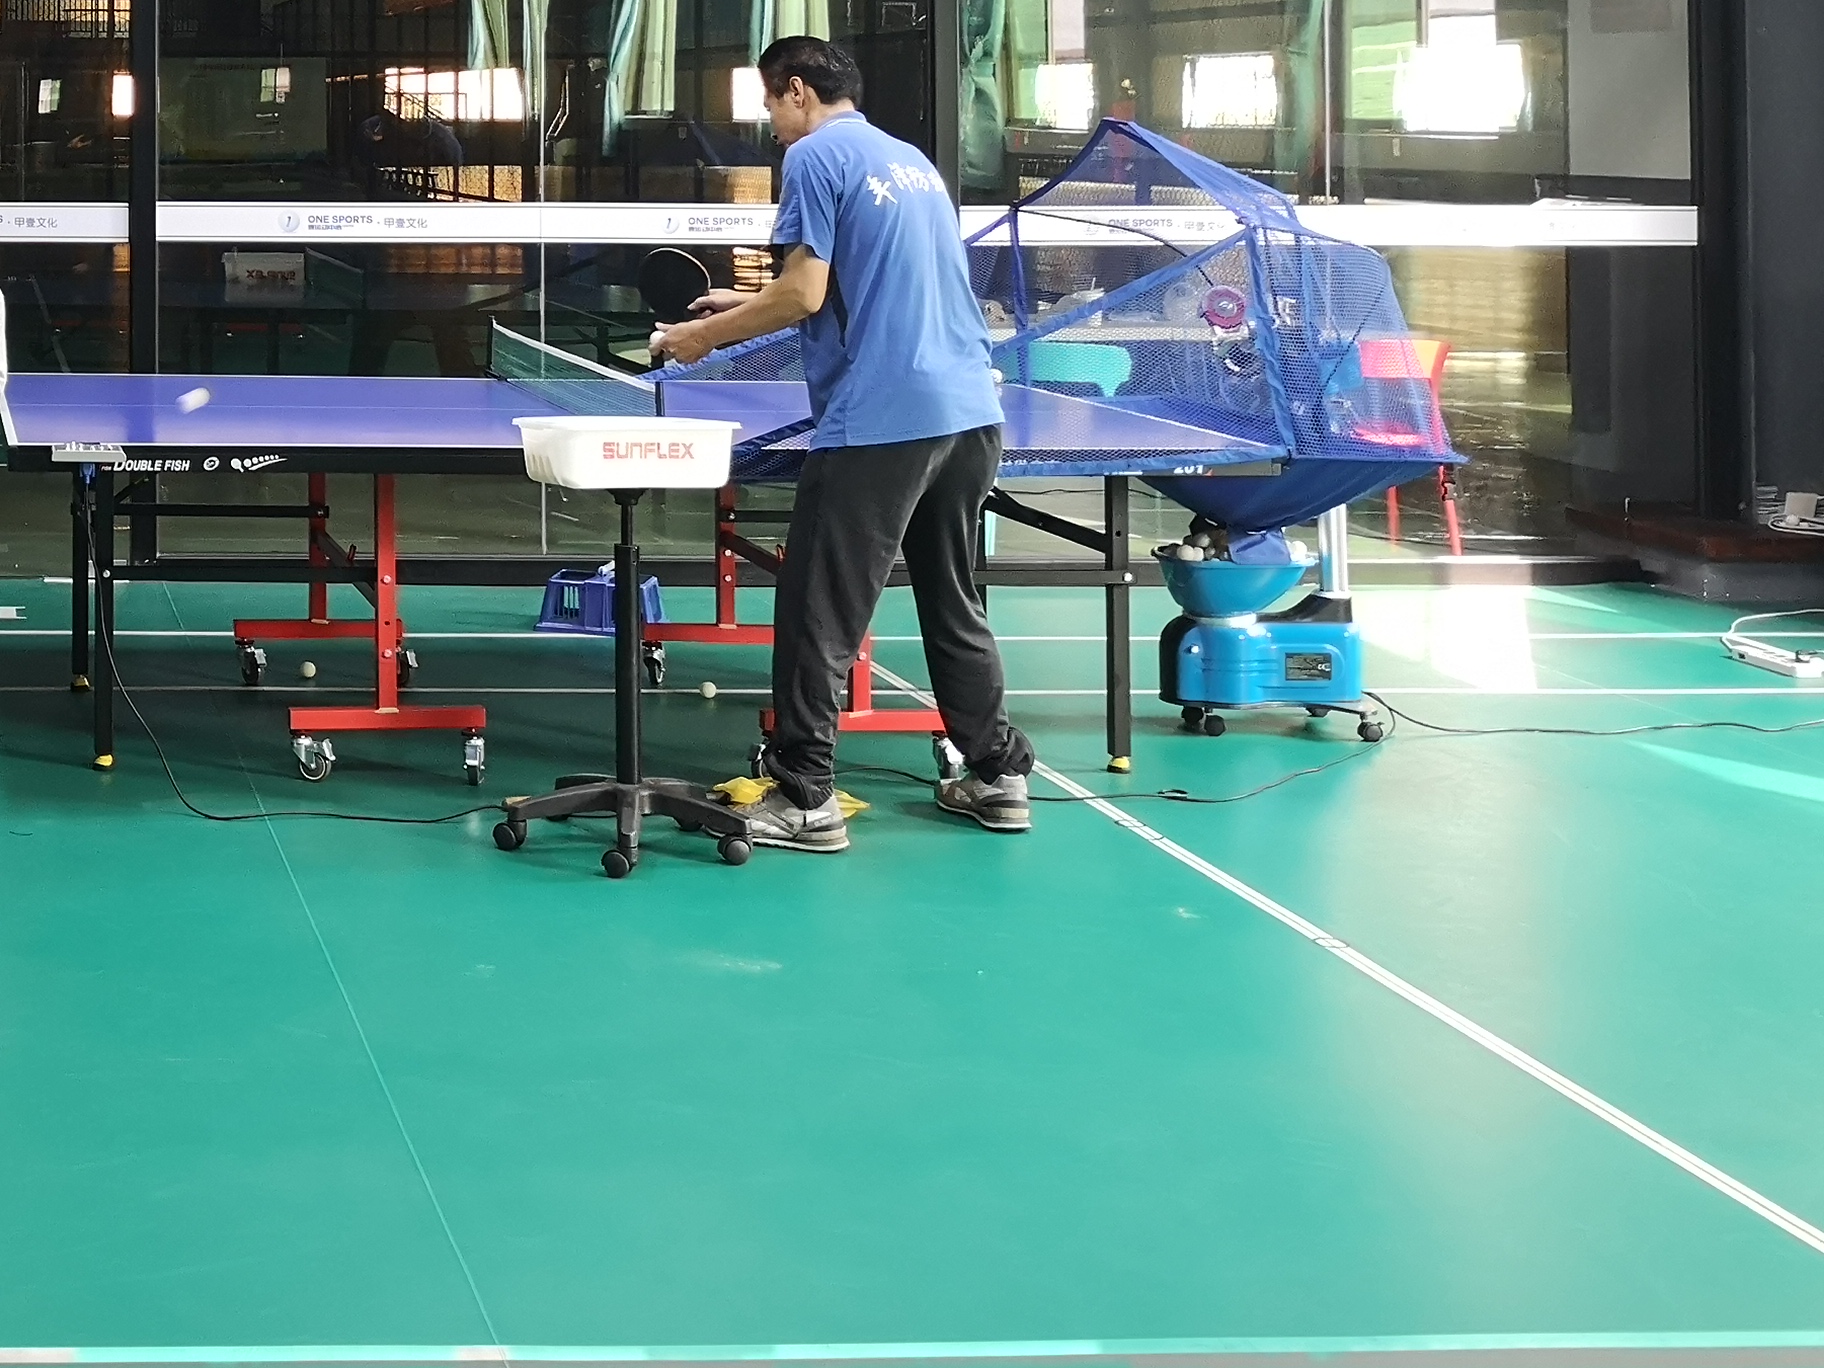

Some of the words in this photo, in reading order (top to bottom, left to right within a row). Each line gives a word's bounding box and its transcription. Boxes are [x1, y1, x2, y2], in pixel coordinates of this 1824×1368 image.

[15, 217, 58, 228] 甲壹文化
[308, 215, 330, 224] ONE
[332, 215, 373, 224] SPORTS
[384, 217, 428, 229] 甲壹文化
[688, 217, 710, 226] ONE
[712, 217, 754, 226] SPORTS
[1132, 218, 1173, 228] SPORTS
[602, 441, 695, 460] SUNFLEX
[113, 459, 163, 472] DOUBLE
[164, 459, 190, 472] FISH
